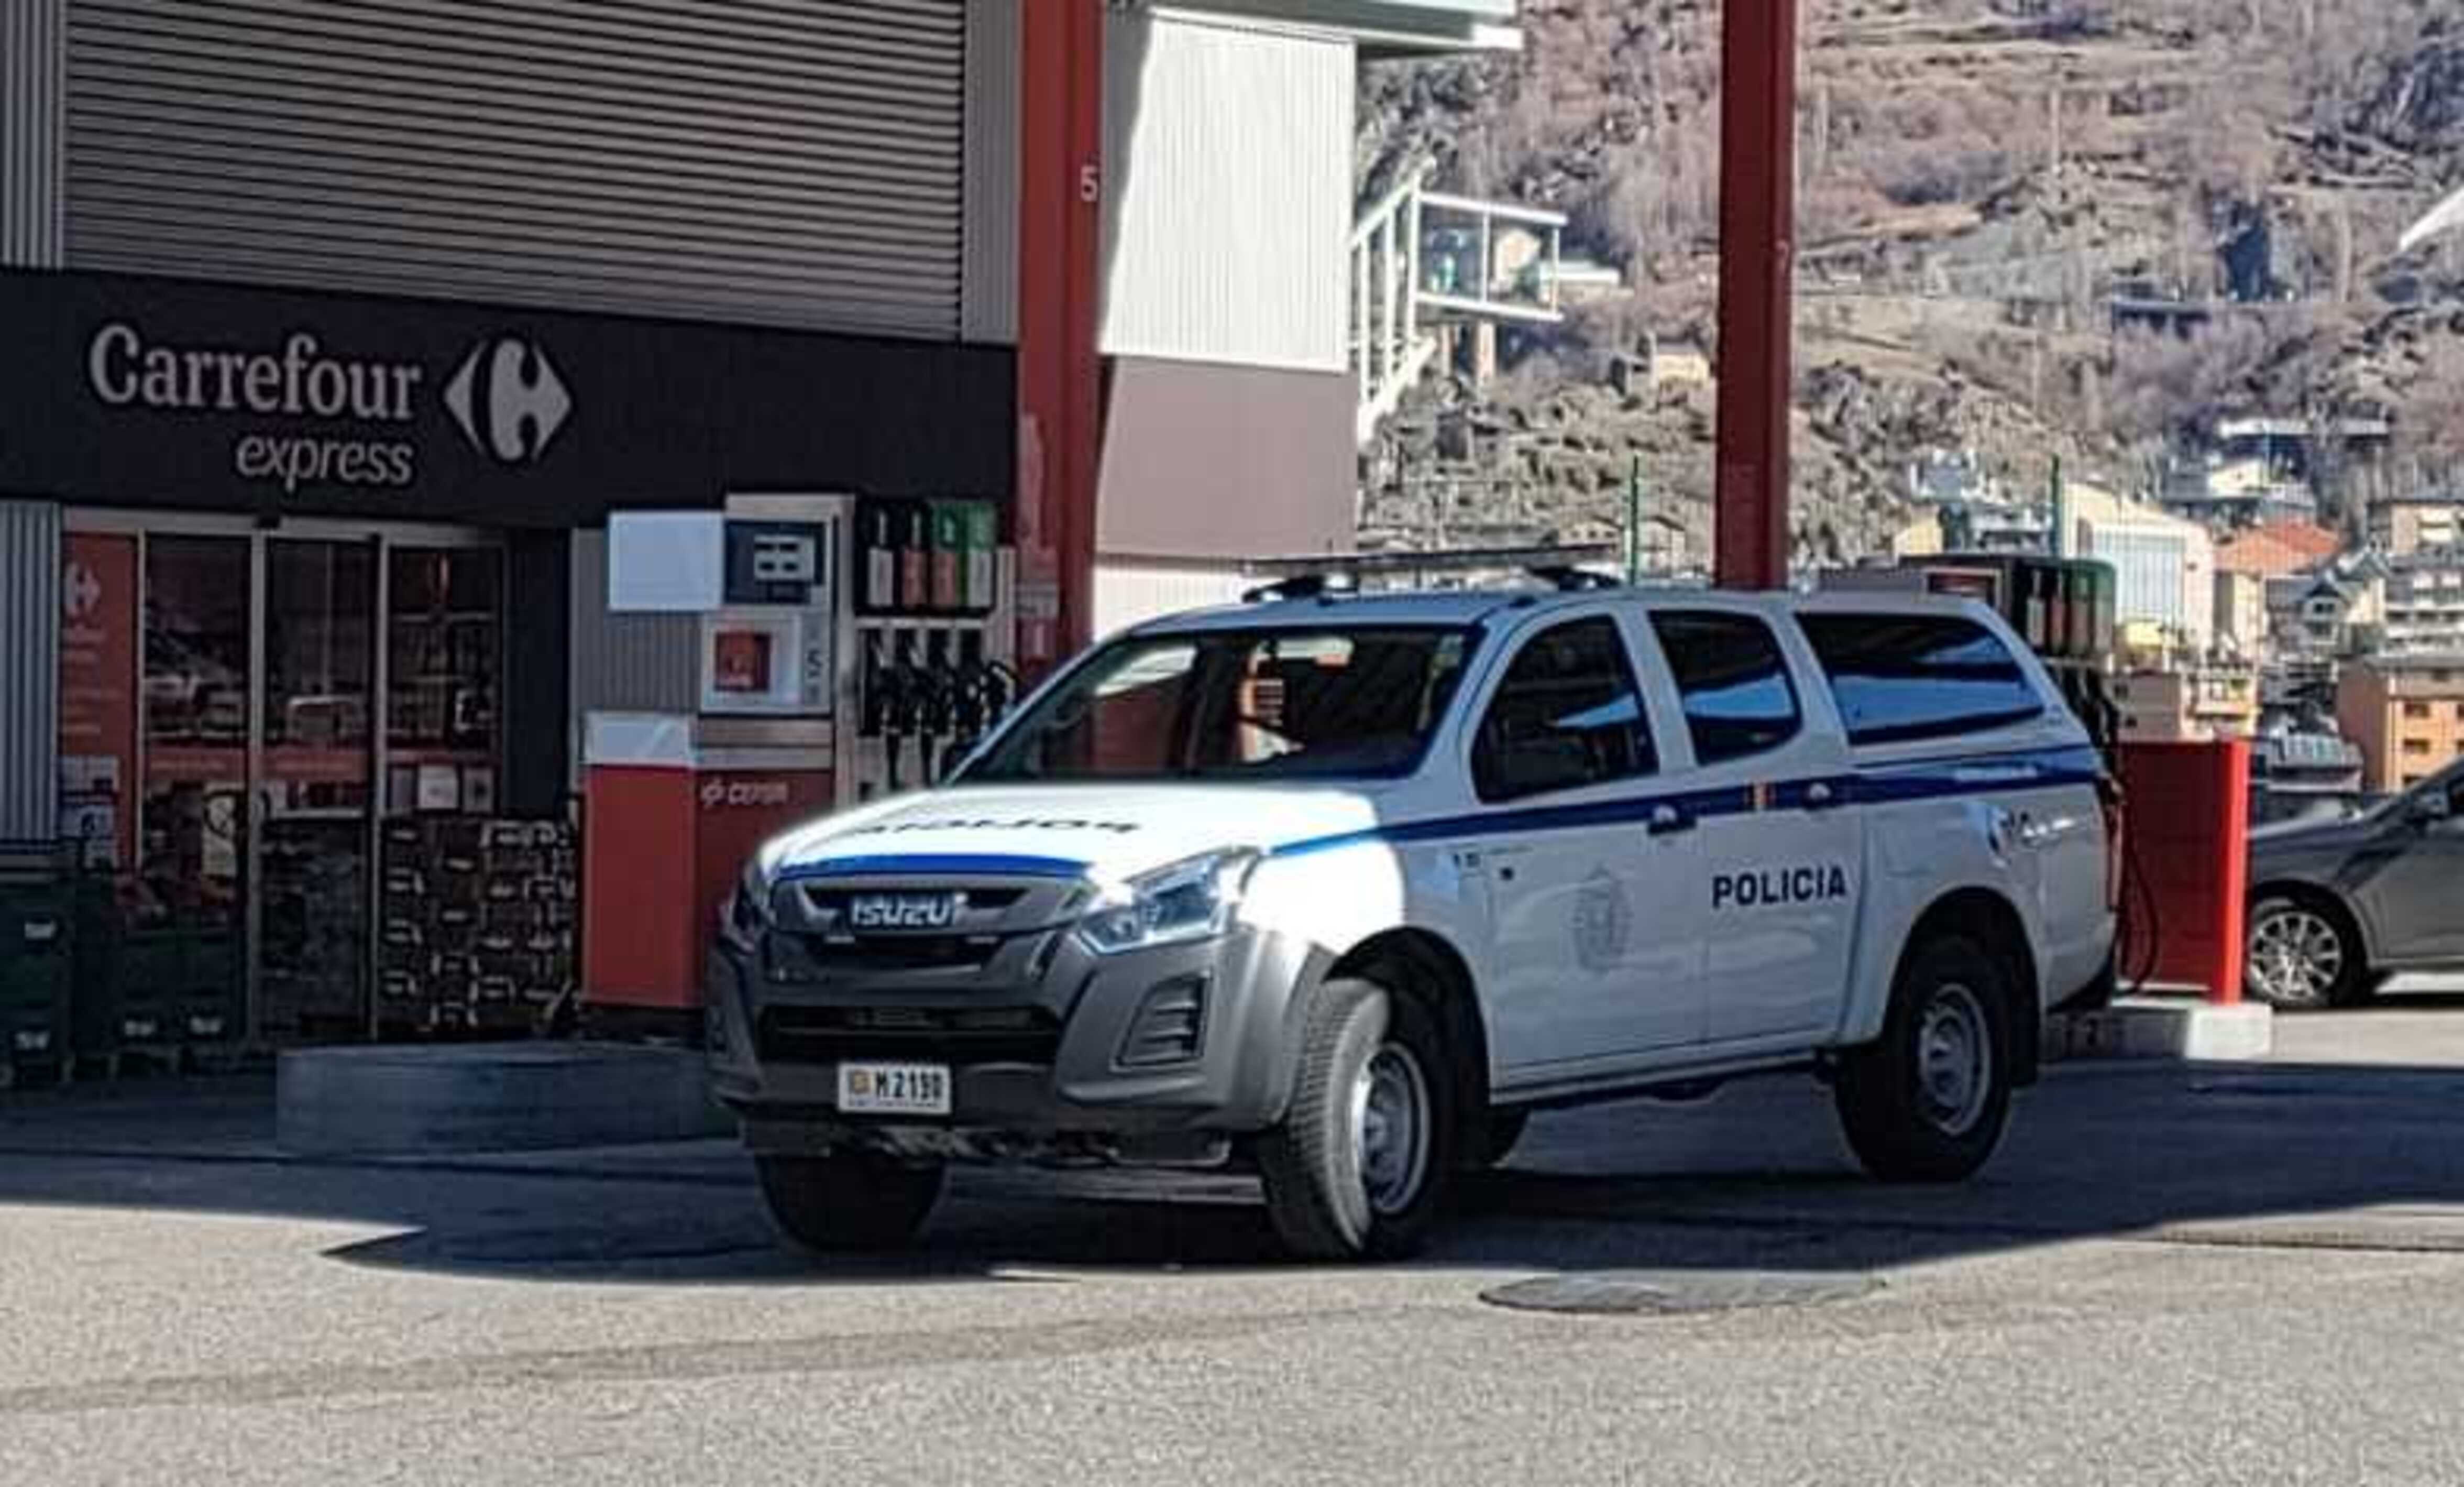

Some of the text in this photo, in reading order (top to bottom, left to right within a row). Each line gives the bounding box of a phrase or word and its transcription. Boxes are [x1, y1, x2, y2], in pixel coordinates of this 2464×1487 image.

[1081, 166, 1098, 202] 5
[90, 324, 421, 418] Carrefour
[236, 434, 412, 490] express
[1712, 867, 1847, 909] POLICIA
[852, 897, 950, 925] ISUZU
